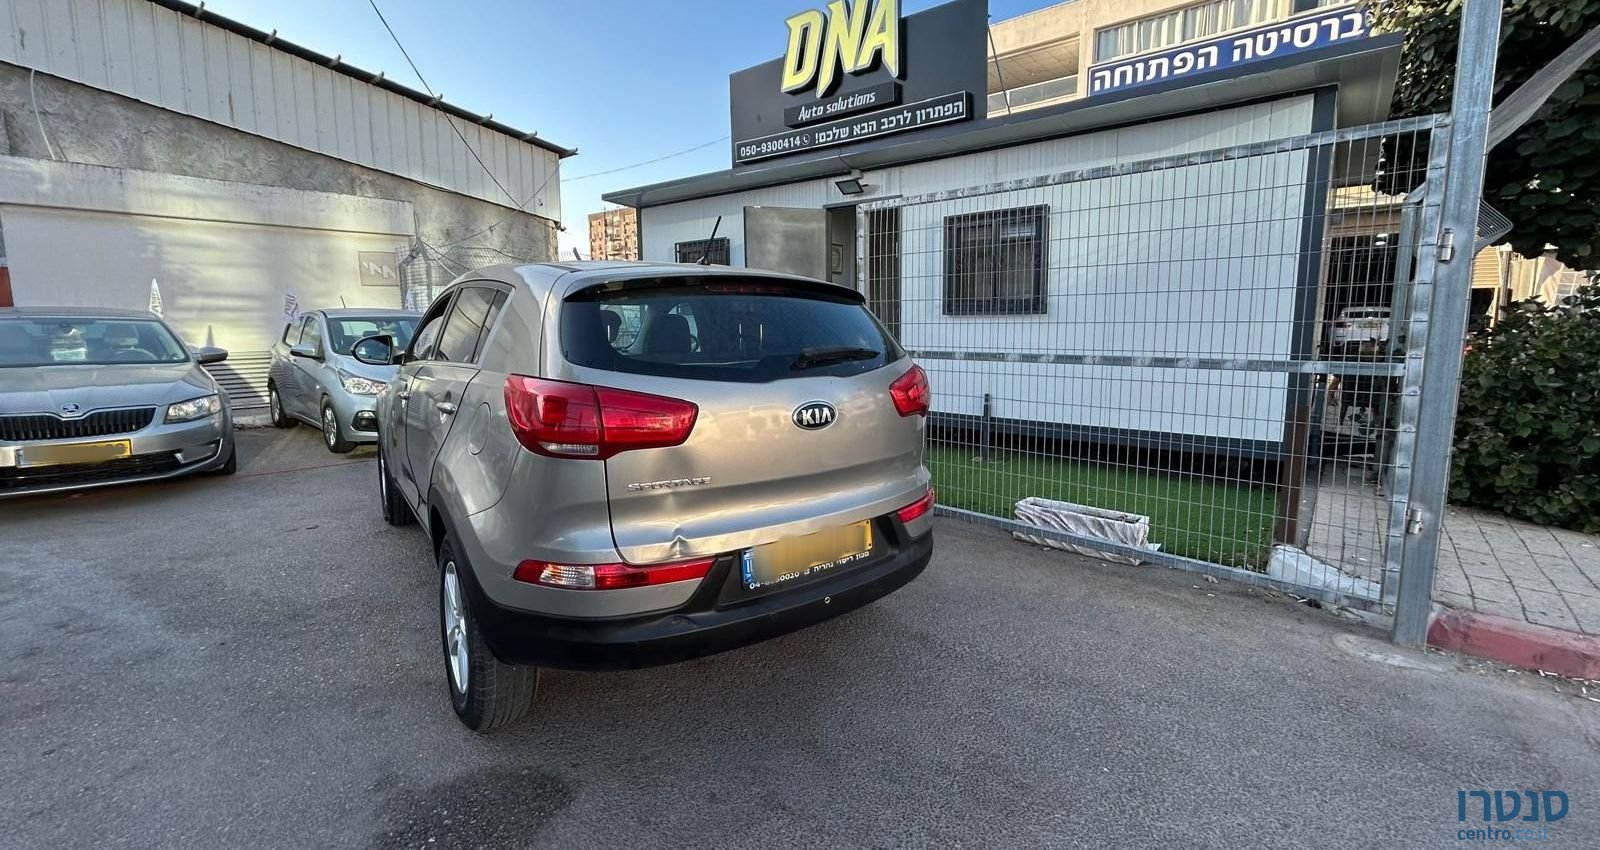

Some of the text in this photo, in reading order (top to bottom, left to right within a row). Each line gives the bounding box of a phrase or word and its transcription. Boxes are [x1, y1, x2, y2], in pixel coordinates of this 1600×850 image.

[781, 0, 900, 98] DNA
[1093, 45, 1218, 92] הפתוחה
[798, 91, 876, 122] Auto solutions
[740, 100, 963, 157] הפתרון לרכב הבא שלכם! 050-9300414
[800, 407, 832, 426] KIA
[627, 476, 713, 493] SPORTAGE
